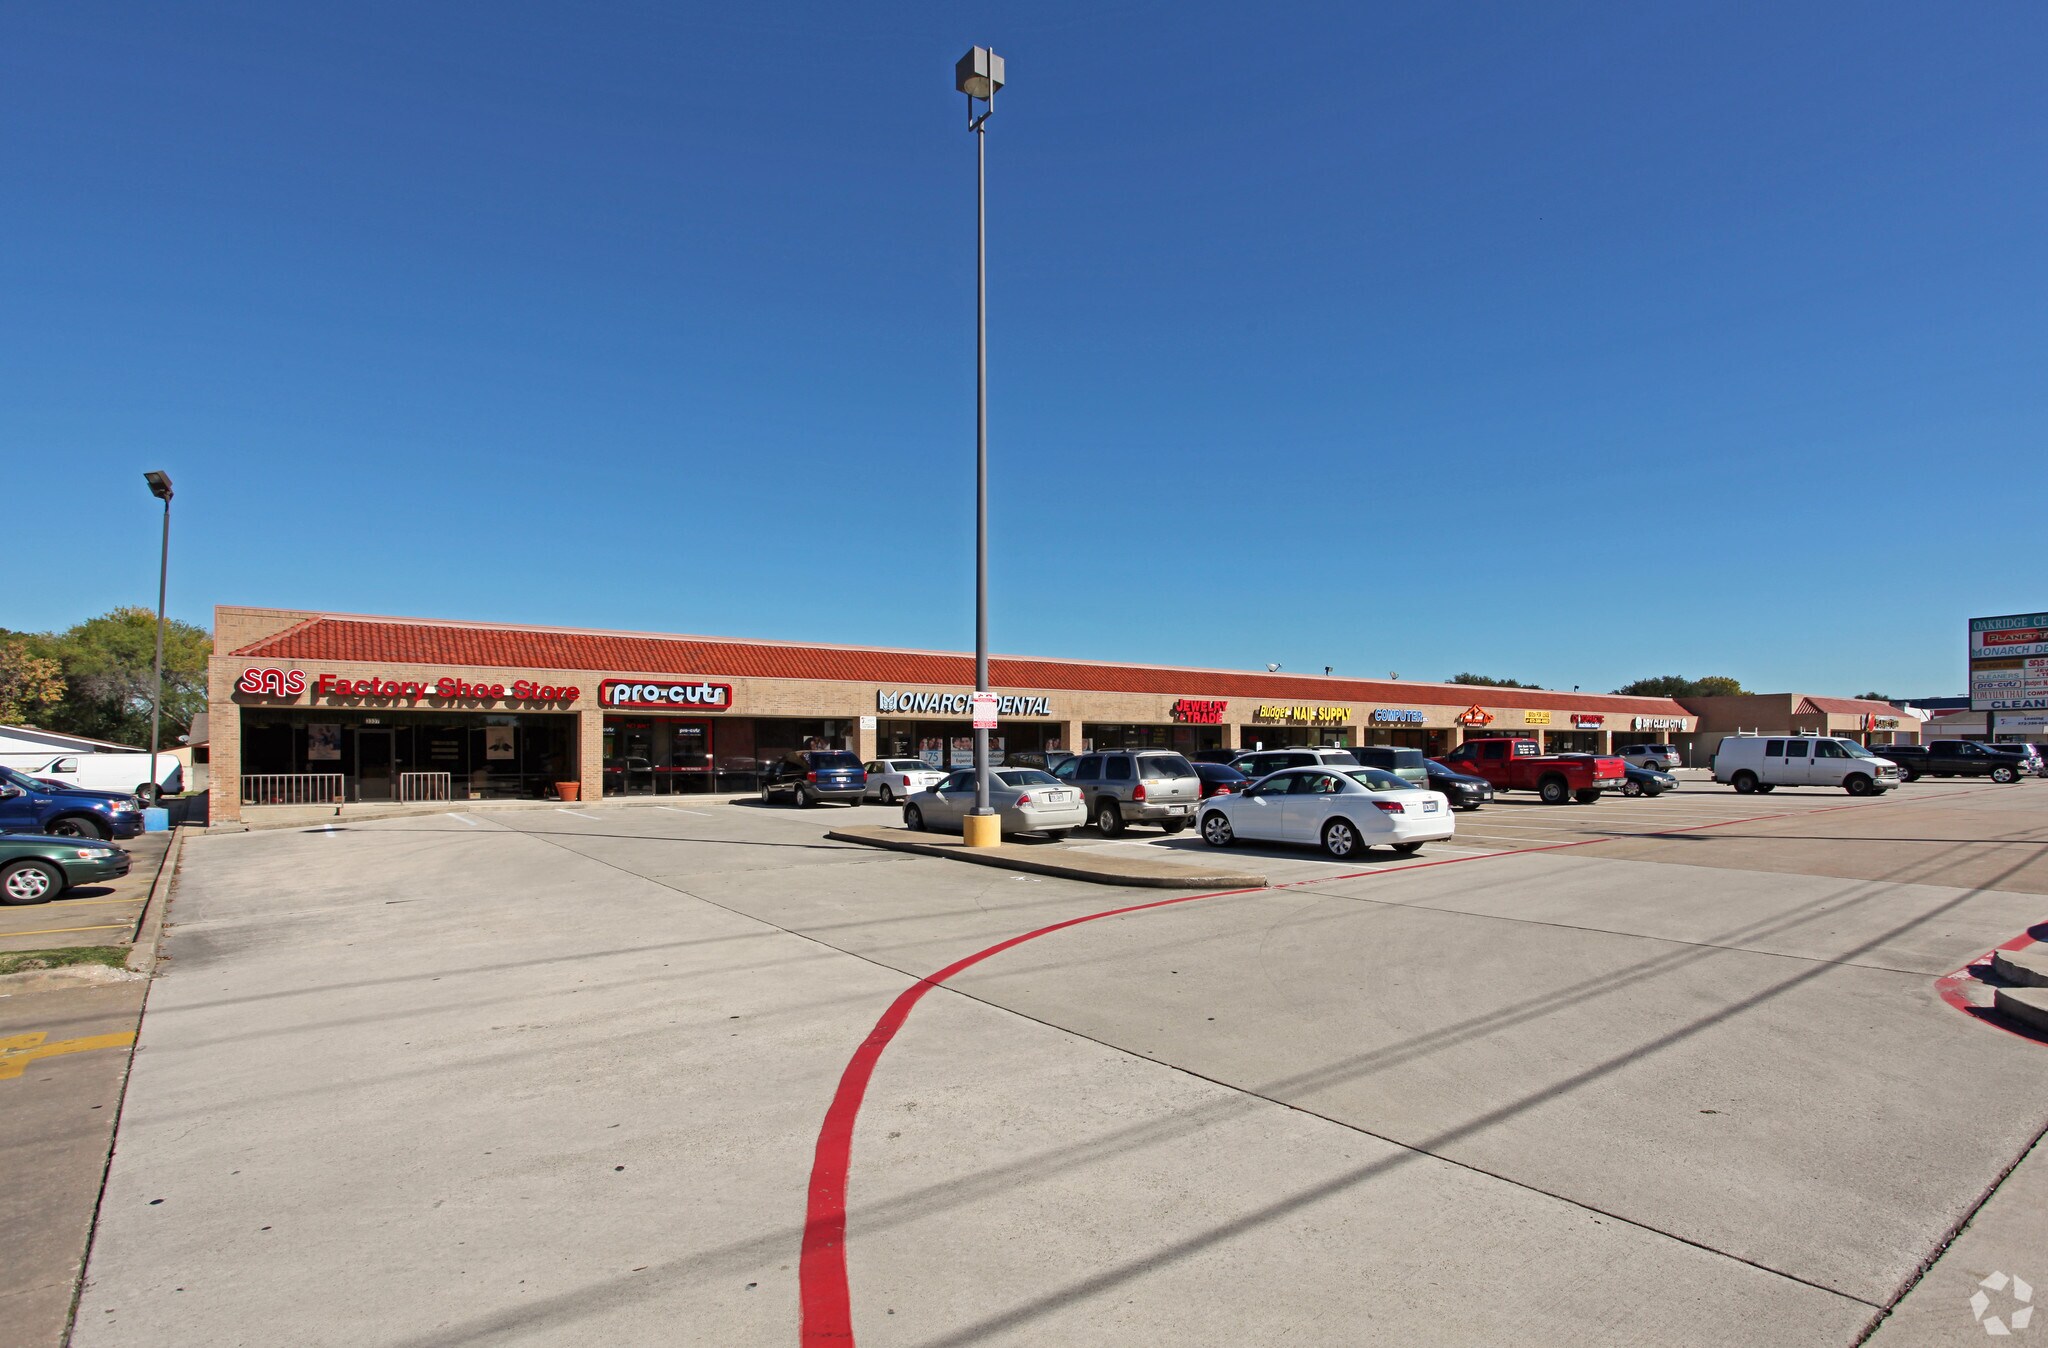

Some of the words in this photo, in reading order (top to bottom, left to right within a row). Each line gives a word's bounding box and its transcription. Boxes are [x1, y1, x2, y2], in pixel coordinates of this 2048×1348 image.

[1973, 617, 2028, 631] OAKRIDGE
[1989, 633, 2036, 642] PLANET
[1972, 645, 2030, 657] MONARCH
[239, 667, 307, 697] SAS
[318, 673, 428, 701] Factory
[437, 677, 504, 699] Shoe
[513, 679, 581, 700] Store
[1977, 681, 2017, 689] pro-cuts
[613, 682, 723, 705] pro-cuts
[1974, 691, 1987, 699] TOM
[1988, 691, 2004, 699] YUM
[2006, 690, 2023, 698] THAI
[1176, 699, 1229, 712] JEWELRY
[1991, 699, 2048, 708] CLEAN
[1186, 711, 1223, 724] TRADE
[1260, 705, 1288, 720] Budget
[1293, 706, 1316, 720] NAIL
[1319, 707, 1352, 721] SUPPLY
[1375, 709, 1423, 722] COMPUTER
[1642, 719, 1654, 728] DRY
[1653, 719, 1669, 729] CLEAN
[1669, 720, 1681, 728] CITY
